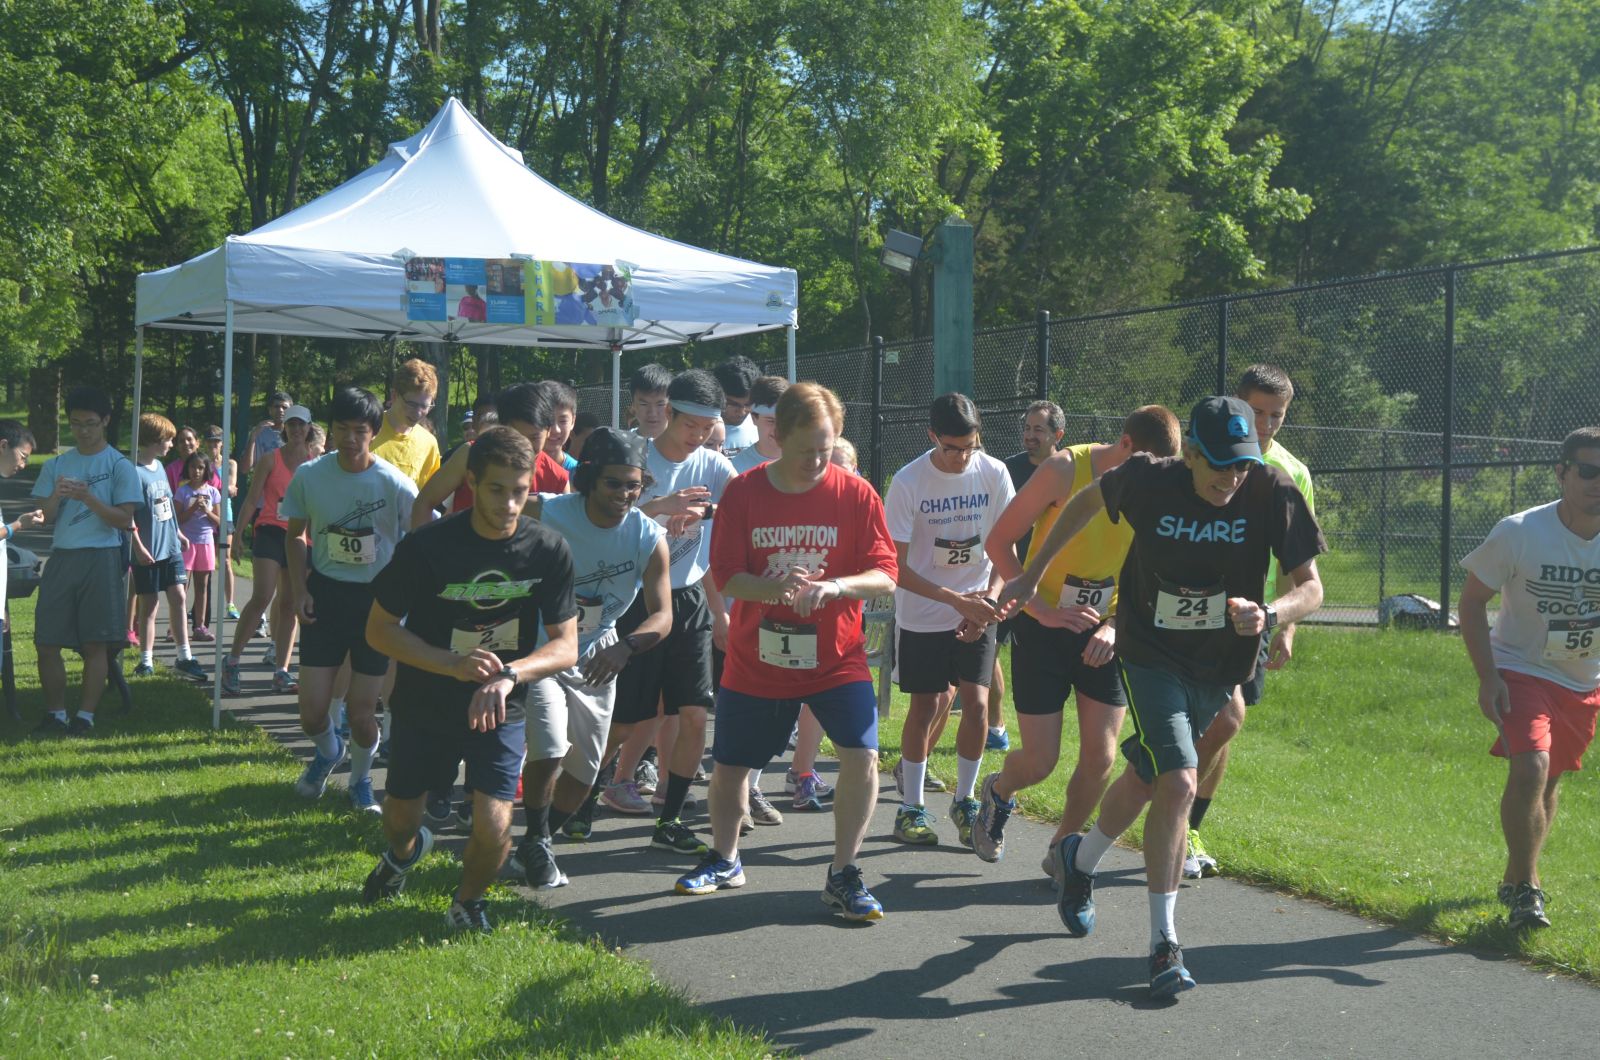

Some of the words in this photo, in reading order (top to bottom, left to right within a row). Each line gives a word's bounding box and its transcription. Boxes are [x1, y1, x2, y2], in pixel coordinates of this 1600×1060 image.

[534, 261, 545, 325] SHARE
[919, 493, 989, 514] CHATHAM
[928, 516, 952, 525] CROSS
[953, 513, 983, 523] COUNTRY
[1155, 514, 1248, 544] SHARE
[339, 536, 363, 554] 40
[751, 525, 838, 549] ASSUMPTION
[947, 548, 972, 565] 25
[1075, 588, 1103, 607] 50
[1175, 597, 1210, 617] 24
[1536, 600, 1600, 616] SOCCE
[479, 630, 494, 645] 2
[780, 634, 792, 655] 1
[1564, 629, 1595, 650] 56
